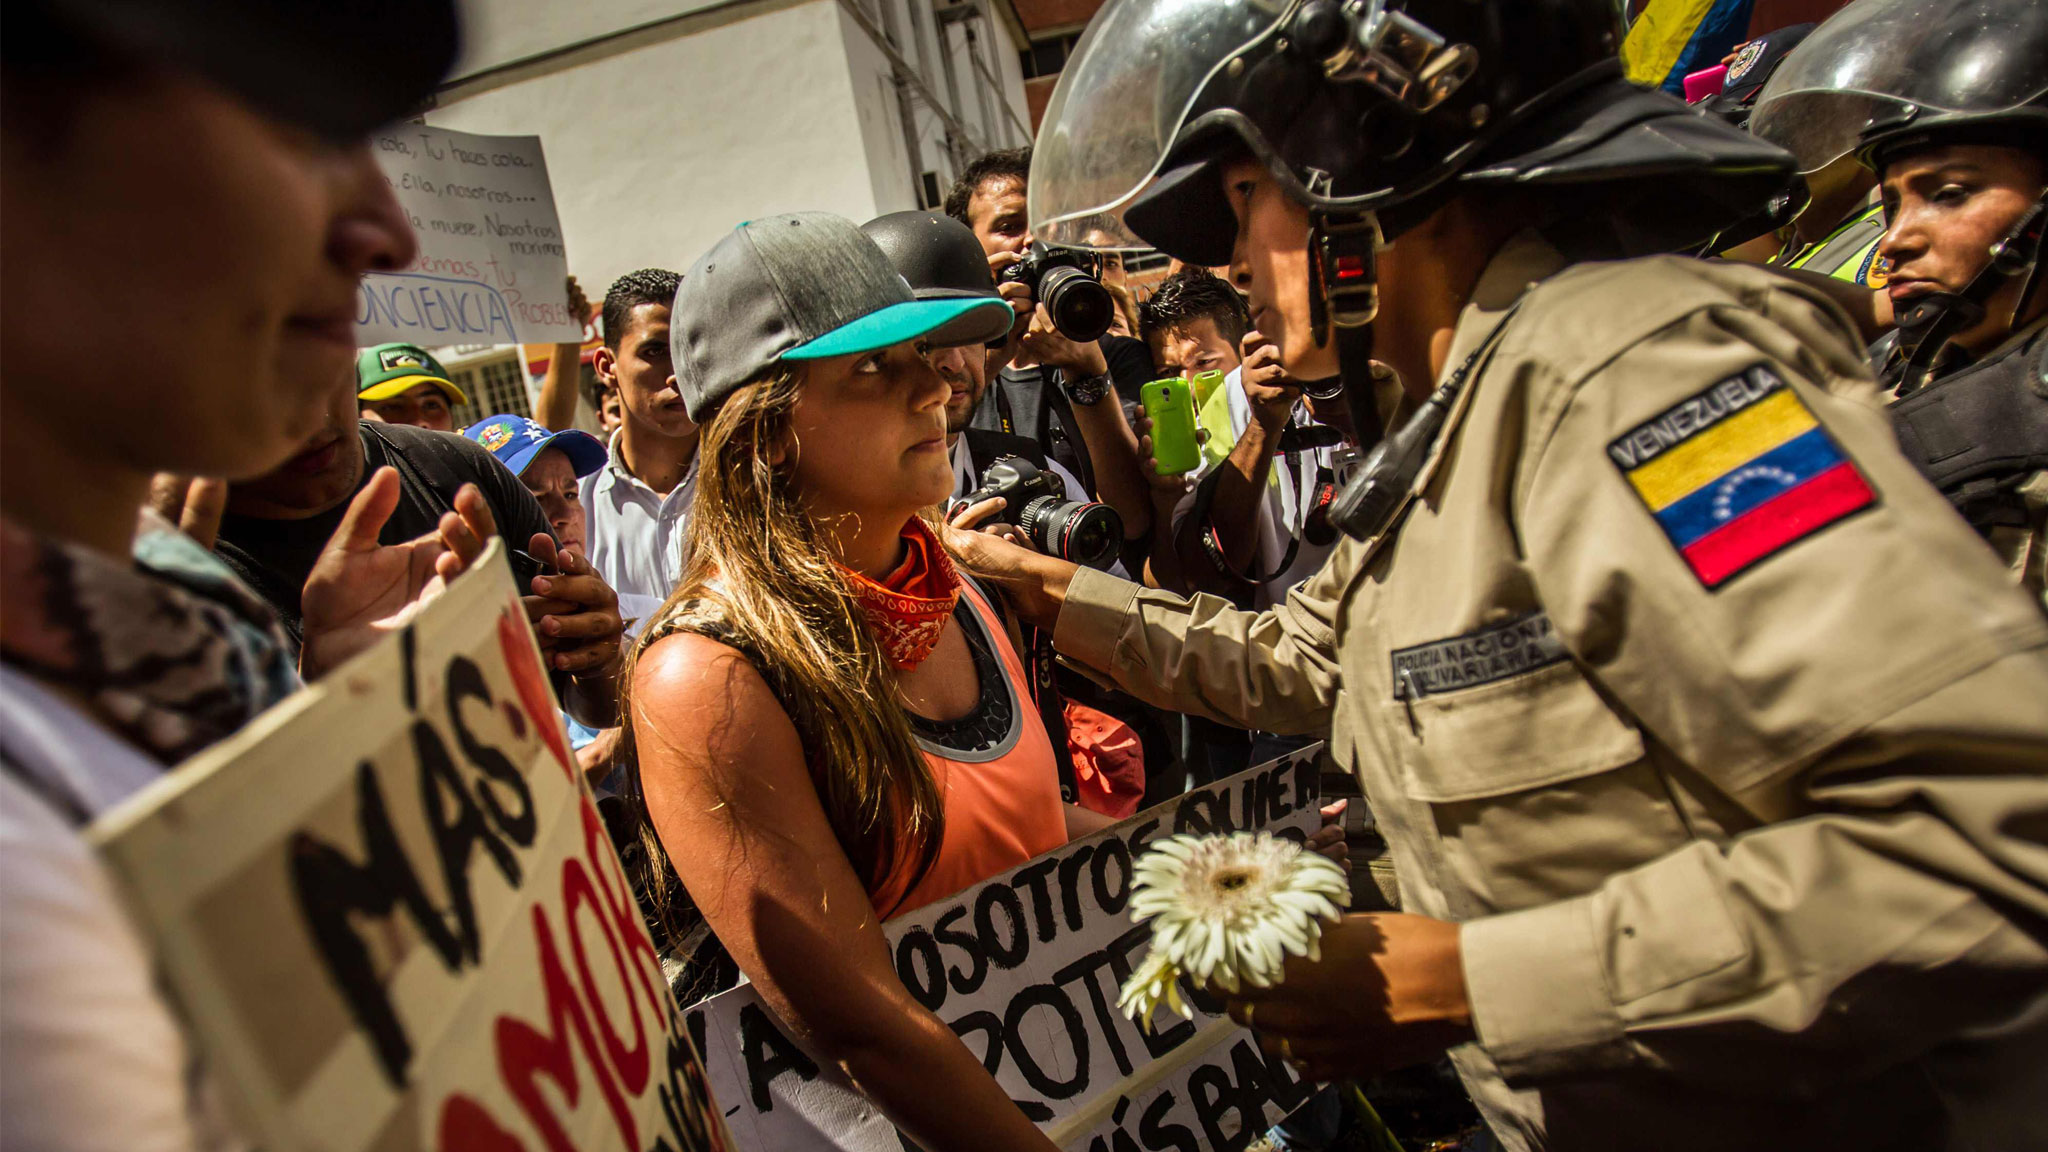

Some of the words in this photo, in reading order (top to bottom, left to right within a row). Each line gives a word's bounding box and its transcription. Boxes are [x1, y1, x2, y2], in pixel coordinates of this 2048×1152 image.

[1047, 248, 1069, 259] Nikon
[356, 283, 506, 337] ONCIENCIA
[1611, 367, 1784, 468] VENEZUELA
[1396, 649, 1443, 673] POLICIA
[1443, 615, 1554, 664] NACIONA
[1412, 641, 1548, 690] OLIVARIANA
[891, 816, 1161, 1013] OSOTROS
